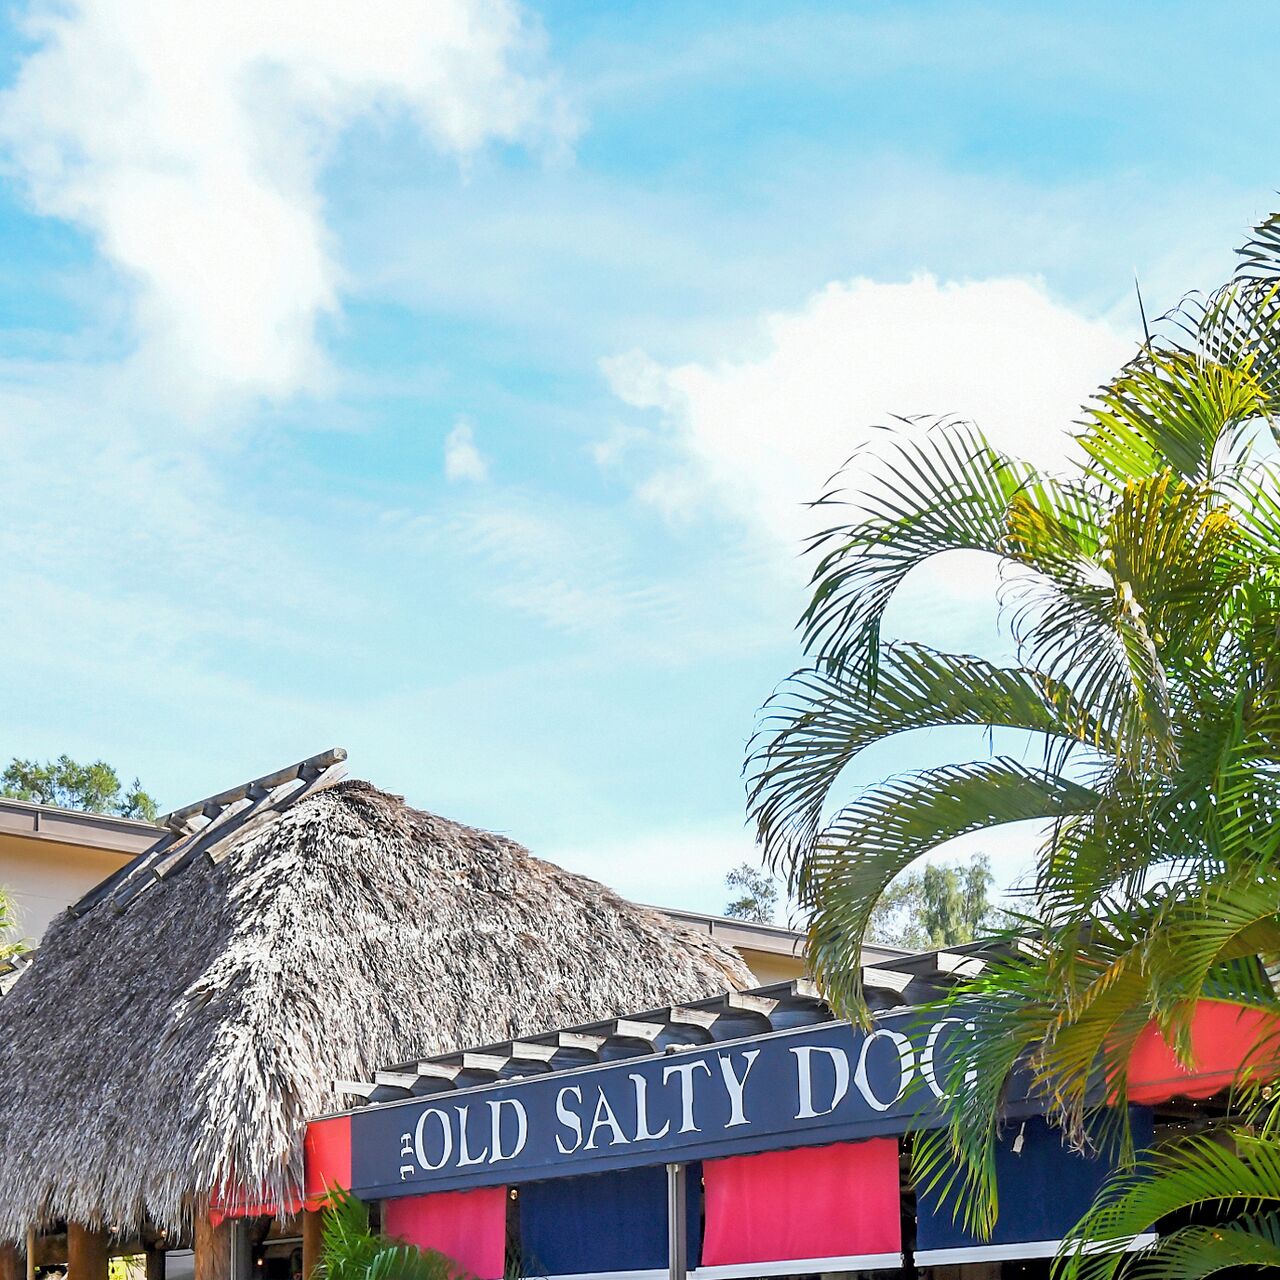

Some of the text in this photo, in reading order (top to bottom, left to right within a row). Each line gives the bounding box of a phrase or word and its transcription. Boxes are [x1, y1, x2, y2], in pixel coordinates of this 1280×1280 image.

[415, 1099, 527, 1170] OLD
[555, 1049, 761, 1154] SALTY
[789, 1018, 978, 1119] DOG
